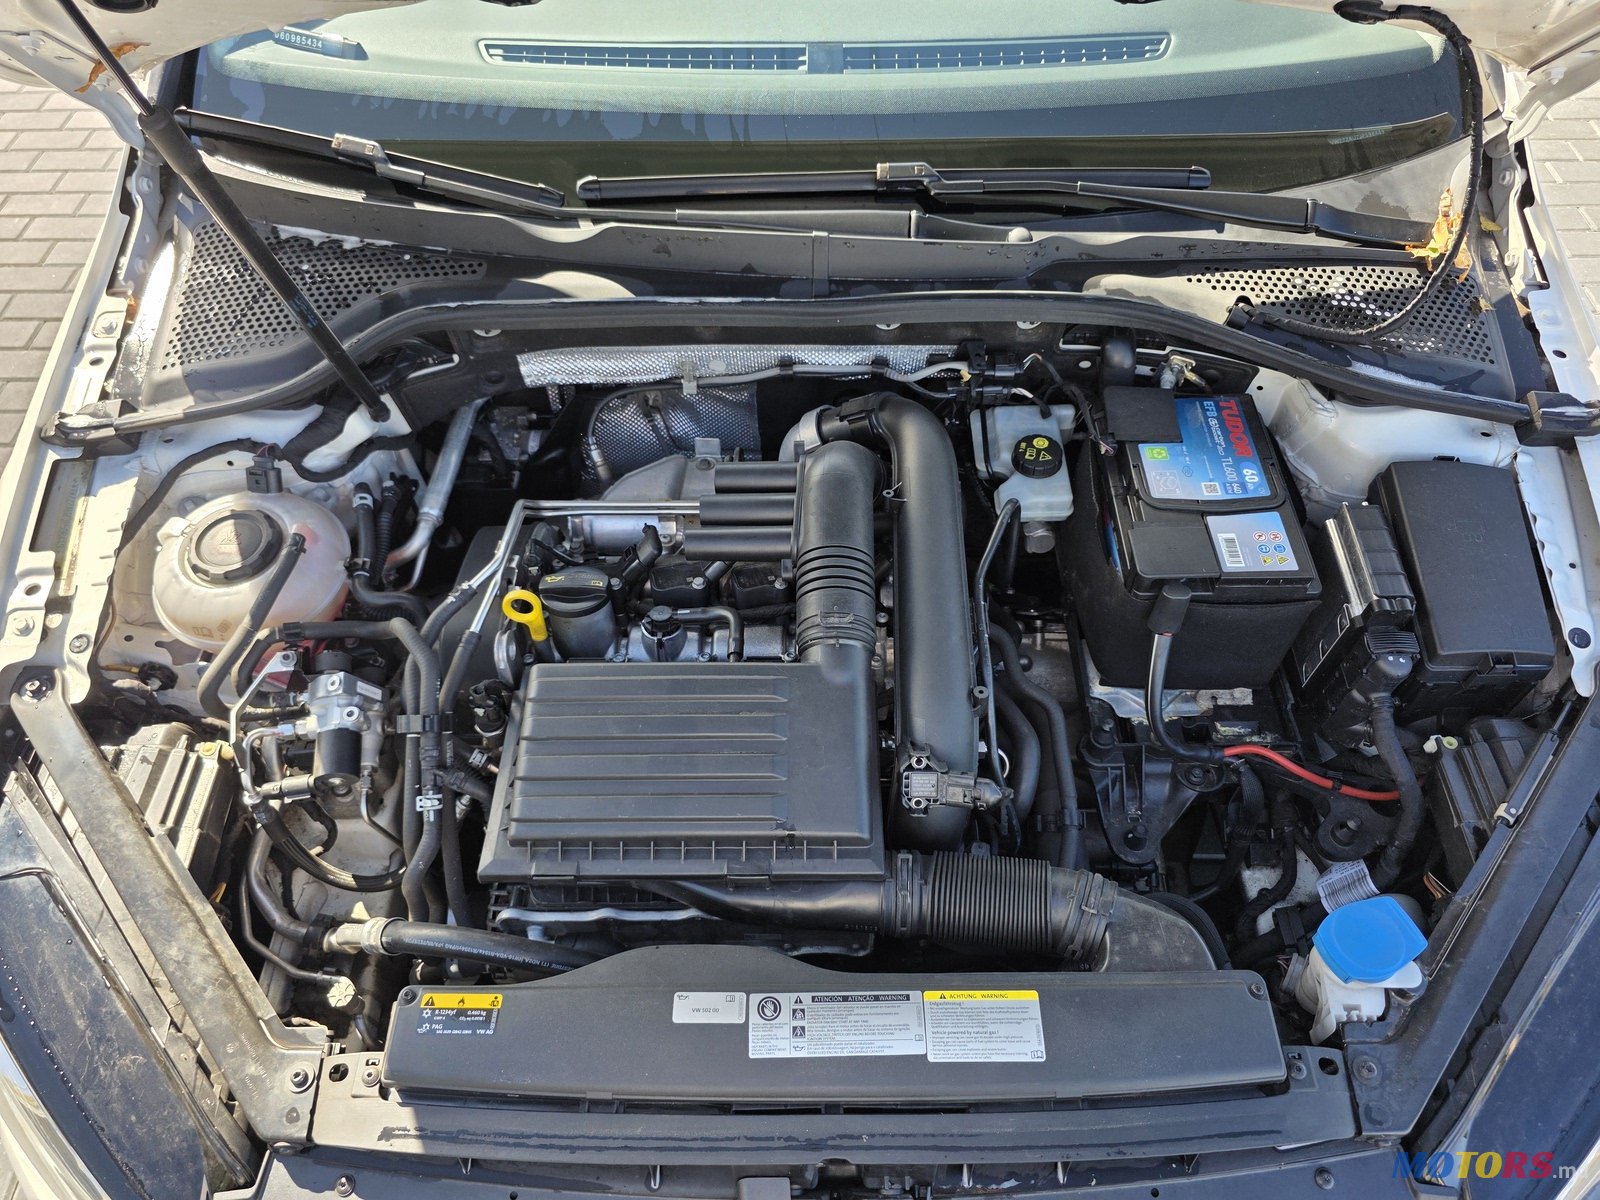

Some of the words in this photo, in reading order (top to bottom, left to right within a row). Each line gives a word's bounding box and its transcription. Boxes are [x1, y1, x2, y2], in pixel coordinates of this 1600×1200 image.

[1203, 401, 1218, 417] EFB
[1219, 400, 1253, 457] TUDOR
[1221, 457, 1238, 481] TL600
[1243, 469, 1258, 482] 60
[814, 994, 843, 1002] ATENCIÓN
[848, 994, 875, 1002] ATENÇÃO
